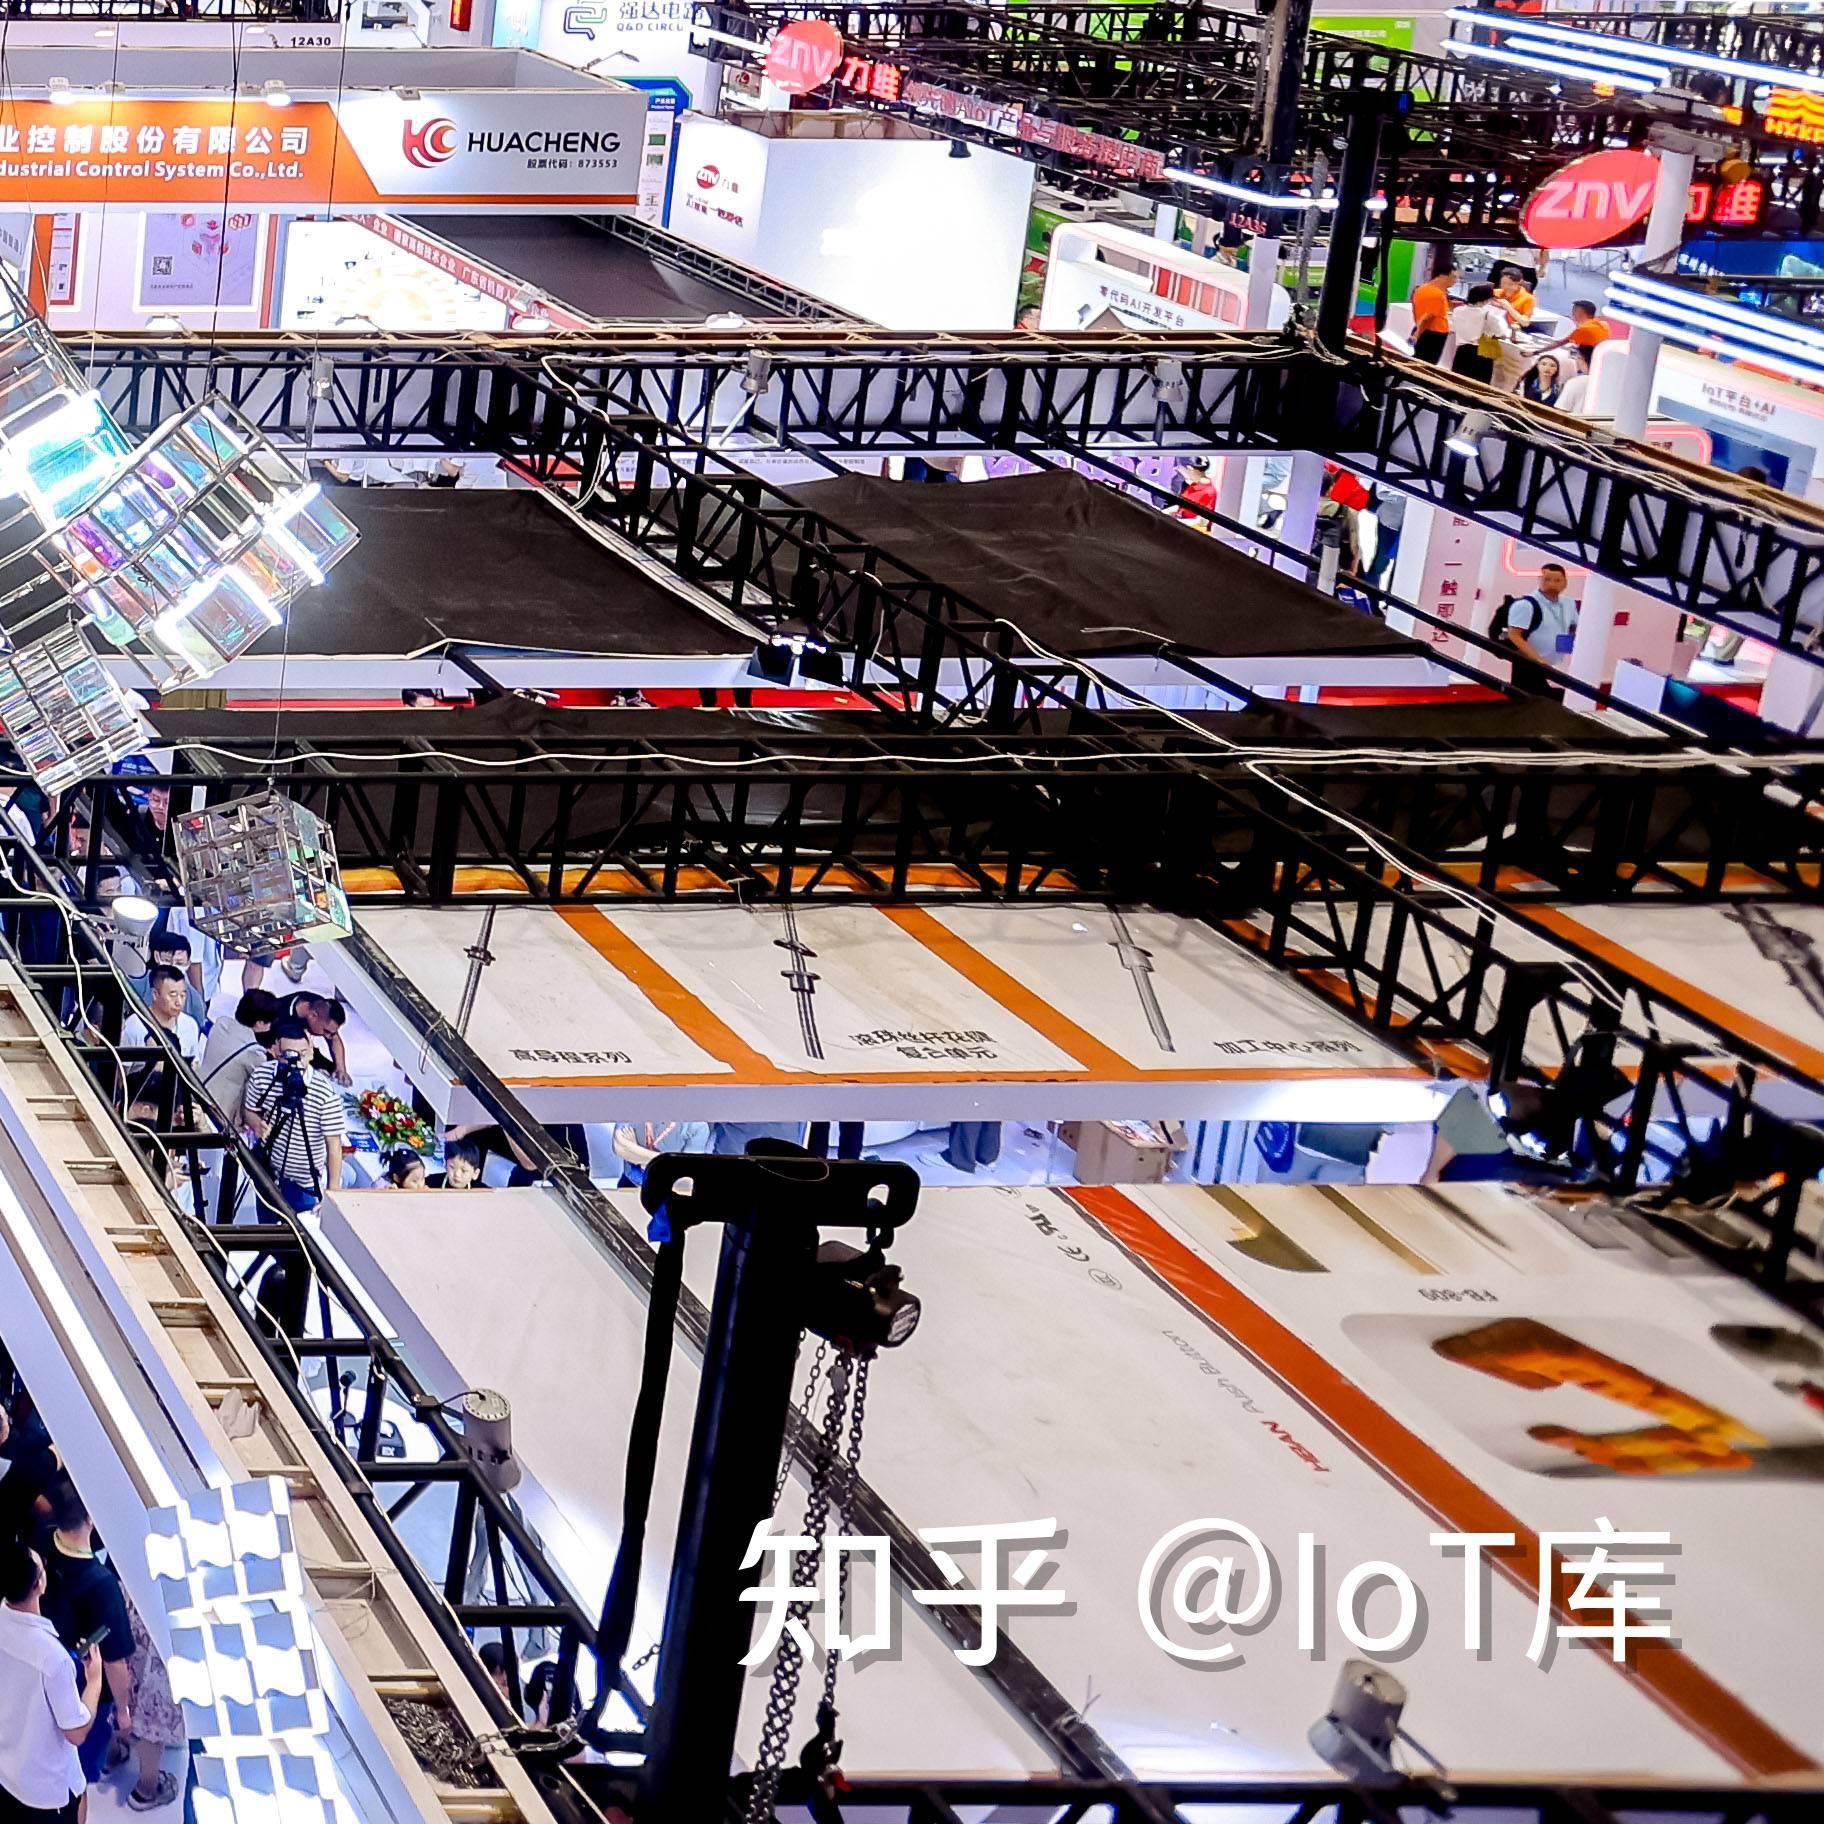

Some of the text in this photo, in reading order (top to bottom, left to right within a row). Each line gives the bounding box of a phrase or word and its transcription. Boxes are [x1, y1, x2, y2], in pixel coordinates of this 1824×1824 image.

[290, 36, 332, 47] 12A30
[843, 55, 902, 100] 力维
[468, 131, 621, 155] HUACHENG
[75, 160, 150, 178] Control
[155, 161, 227, 181] System
[508, 1047, 633, 1066] 高导程系列
[1212, 1038, 1364, 1056] 加工中心系列
